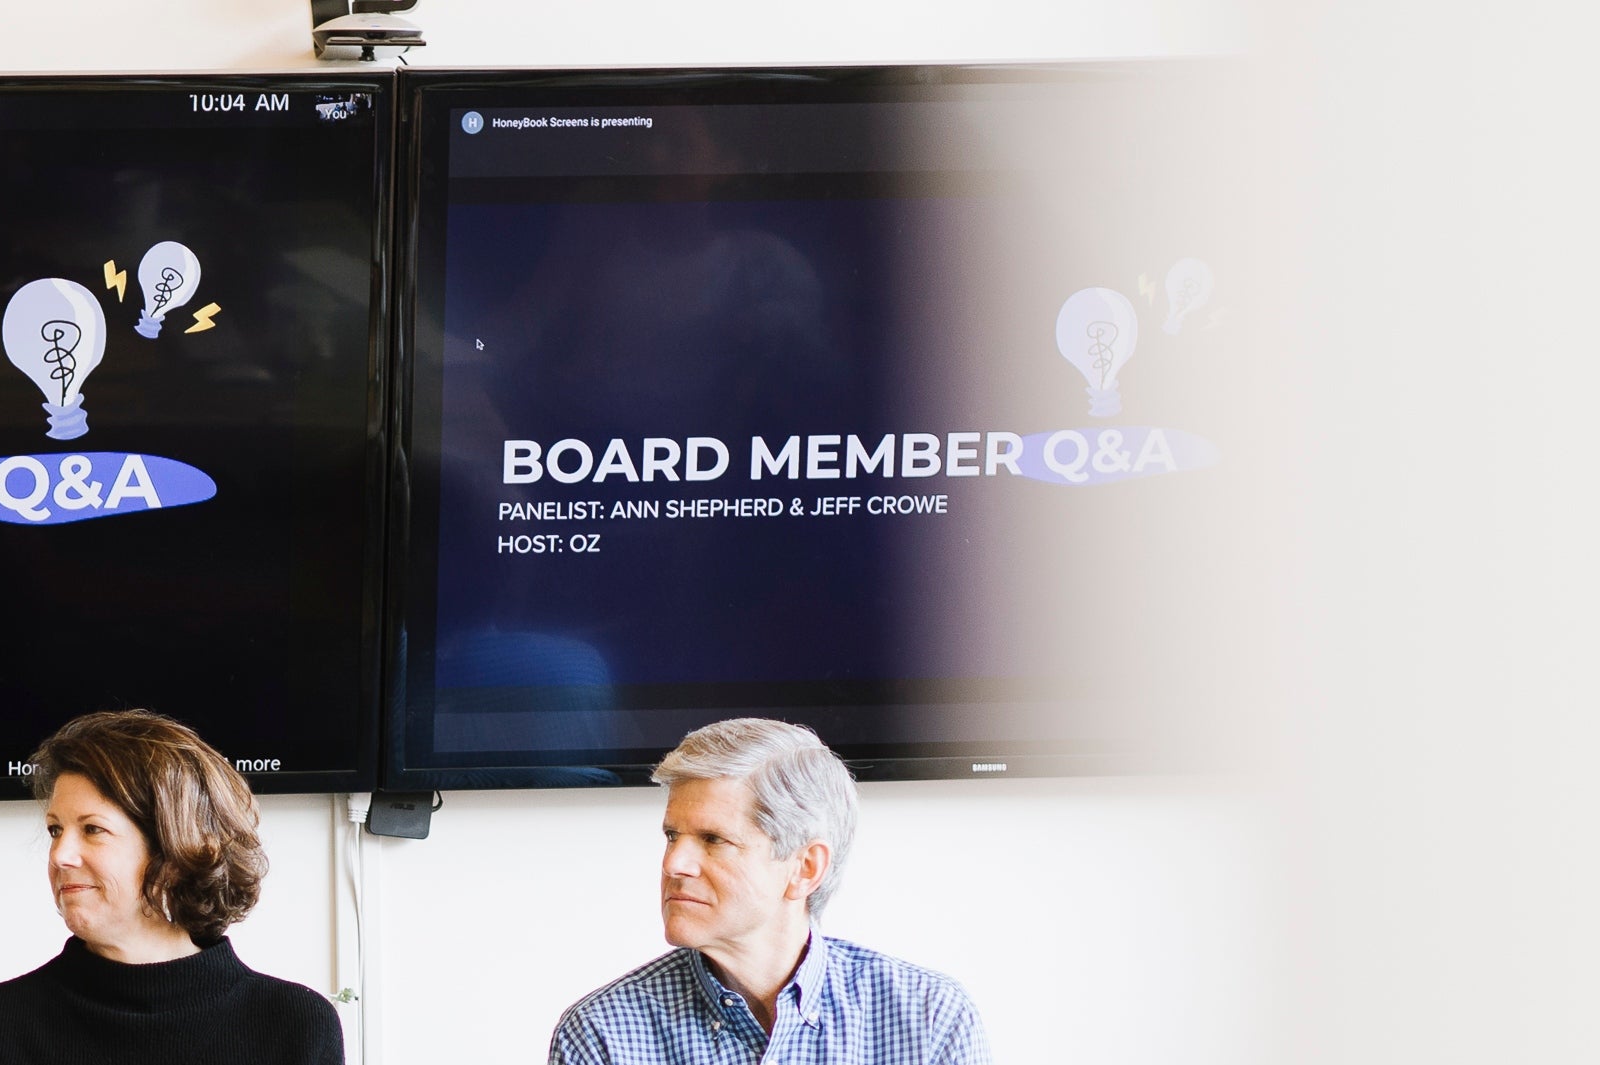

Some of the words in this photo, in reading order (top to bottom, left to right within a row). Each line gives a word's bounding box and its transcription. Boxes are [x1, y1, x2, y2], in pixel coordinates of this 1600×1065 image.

[189, 93, 246, 112] 10:04
[254, 93, 289, 112] AM
[325, 108, 348, 120] You
[468, 117, 477, 128] H
[492, 117, 548, 130] HoneyBook
[549, 117, 589, 128] Screens
[590, 116, 600, 127] is
[601, 116, 653, 129] presenting
[503, 437, 730, 485] BOARD
[750, 430, 1023, 482] MEMBER
[1043, 429, 1177, 483] Q&A
[498, 501, 605, 521] PANELIST:
[609, 500, 659, 519] ANN
[665, 498, 784, 519] SHEPHERD
[789, 497, 804, 516] &
[810, 496, 862, 516] JEFF
[866, 494, 949, 515] CROWE
[497, 534, 564, 554] HOST:
[569, 533, 601, 553] OZ
[235, 758, 281, 772] more
[972, 763, 1007, 772] SAMSUNG
